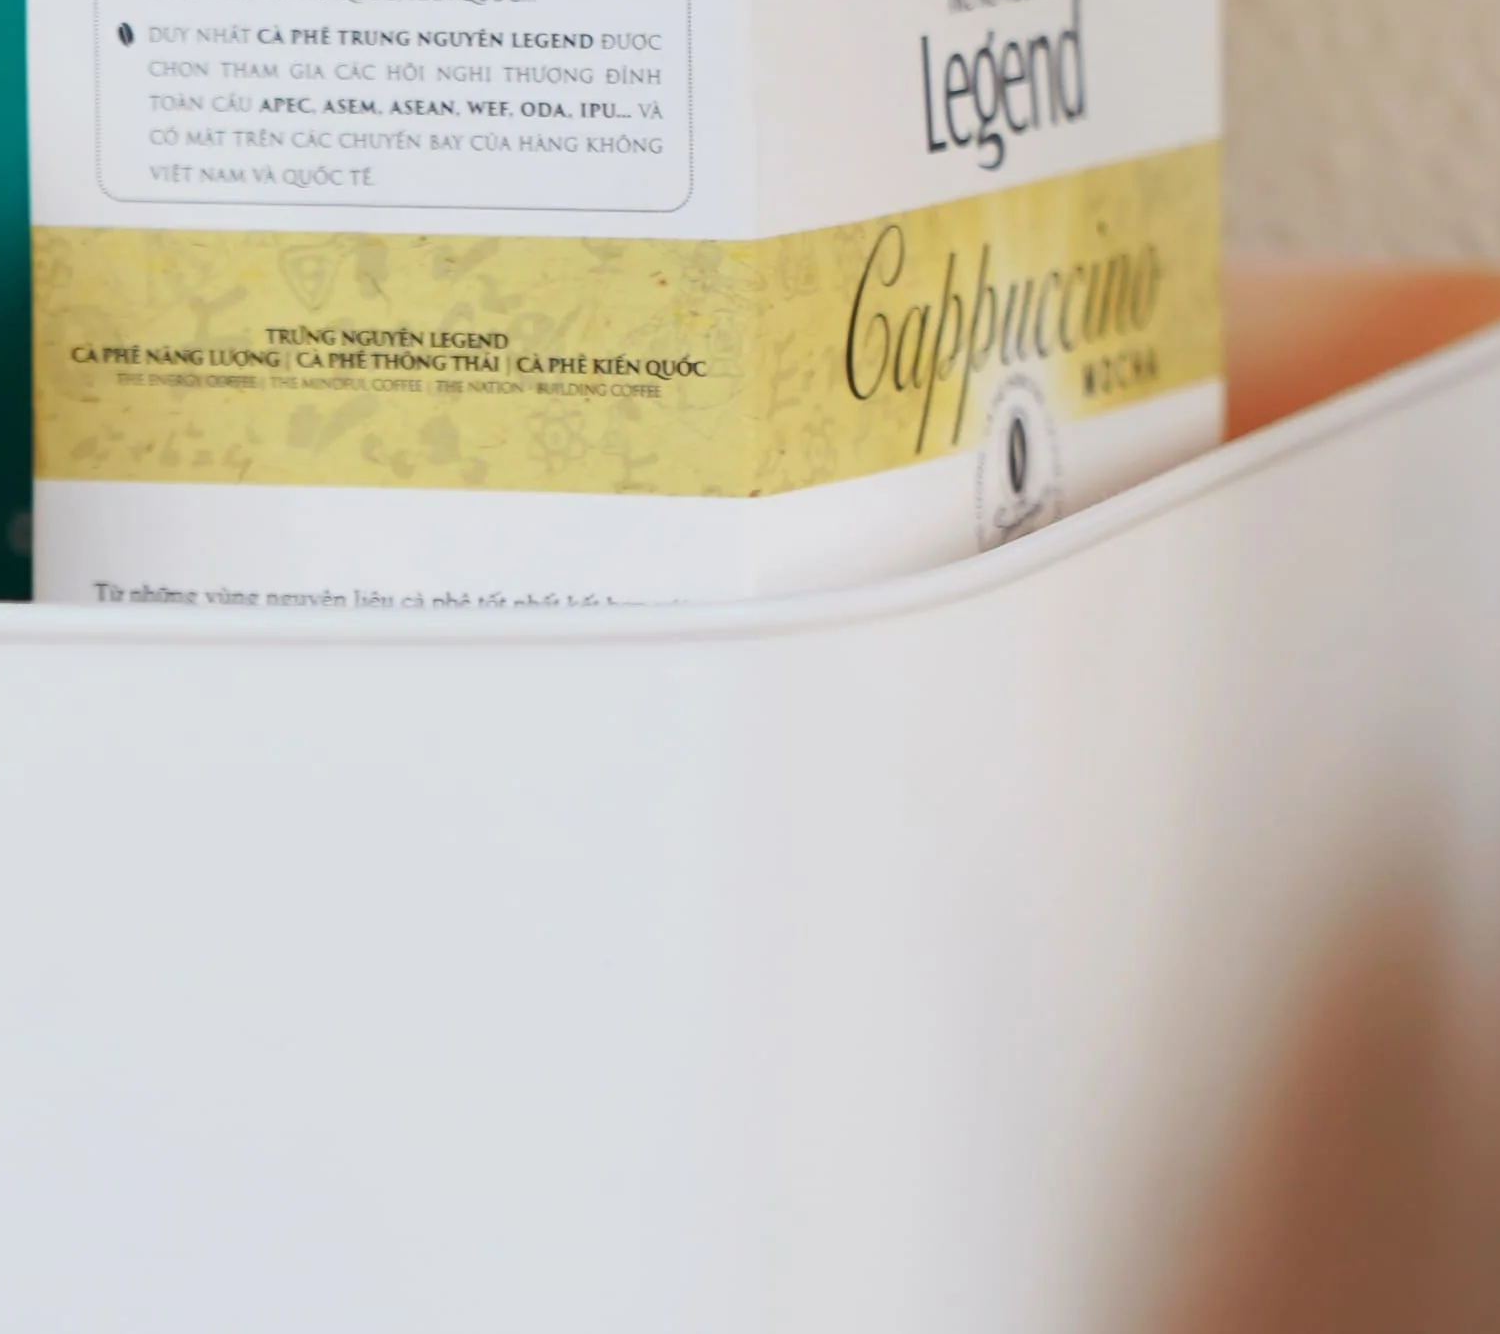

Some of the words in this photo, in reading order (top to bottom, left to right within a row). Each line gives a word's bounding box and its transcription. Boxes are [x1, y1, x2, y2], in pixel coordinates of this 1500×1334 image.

[148, 26, 190, 44] DUY
[257, 24, 285, 44] CÀ
[290, 24, 332, 45] PHÊ
[339, 29, 411, 47] TRUNG
[417, 27, 504, 48] NGUYÊN
[511, 32, 594, 49] LEGEND
[220, 61, 279, 78] THAM
[289, 62, 326, 80] GIA
[334, 61, 378, 81] CÁC
[148, 91, 204, 112] TOÀN
[638, 100, 664, 120] VÀ
[148, 126, 178, 146] CÓ
[232, 127, 284, 148] TRÊN
[291, 128, 333, 149] CÁC
[430, 133, 463, 151] BAY
[519, 131, 579, 153] HÀNG
[586, 132, 664, 155] KHÔNG
[199, 165, 246, 184] NAM
[251, 163, 277, 184] VÀ
[282, 163, 345, 188] QUỐC
[266, 327, 337, 345] TRUNG
[341, 327, 424, 348] NGUYÊN
[430, 331, 510, 350] LEGEND
[846, 224, 1160, 455] Cappuccino
[70, 342, 98, 364] CÀ
[102, 343, 141, 365] PHÊ
[296, 348, 326, 369] CÀ
[329, 348, 368, 370] PHÊ
[371, 351, 447, 372] THÔNG
[517, 352, 545, 374] CÀ
[548, 352, 588, 375] PHÊ
[593, 351, 641, 376] KIẾN
[645, 352, 708, 380] QUỐC
[270, 376, 298, 389] THE
[372, 378, 422, 393] COFFEE
[467, 380, 523, 395] NATION
[611, 383, 662, 399] COFFEE
